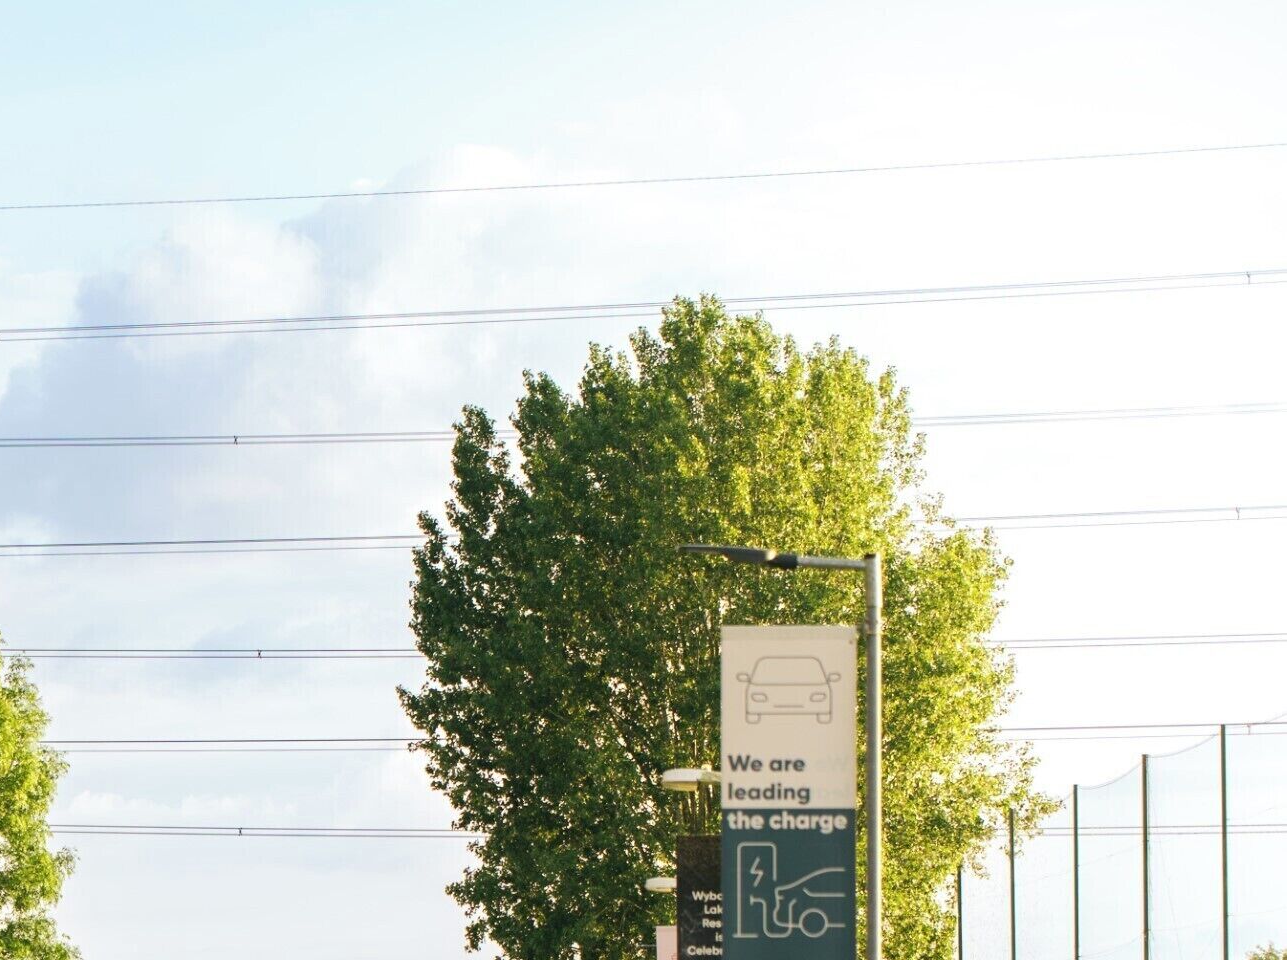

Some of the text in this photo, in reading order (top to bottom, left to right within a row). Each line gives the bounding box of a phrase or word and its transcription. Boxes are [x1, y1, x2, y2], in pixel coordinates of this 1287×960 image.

[728, 755, 806, 773] We are
[727, 783, 811, 804] leading
[727, 811, 848, 834] the charge
[692, 891, 723, 902] Wybo
[704, 905, 723, 915] Lak
[702, 918, 723, 928] Res
[687, 945, 723, 955] Celebr
